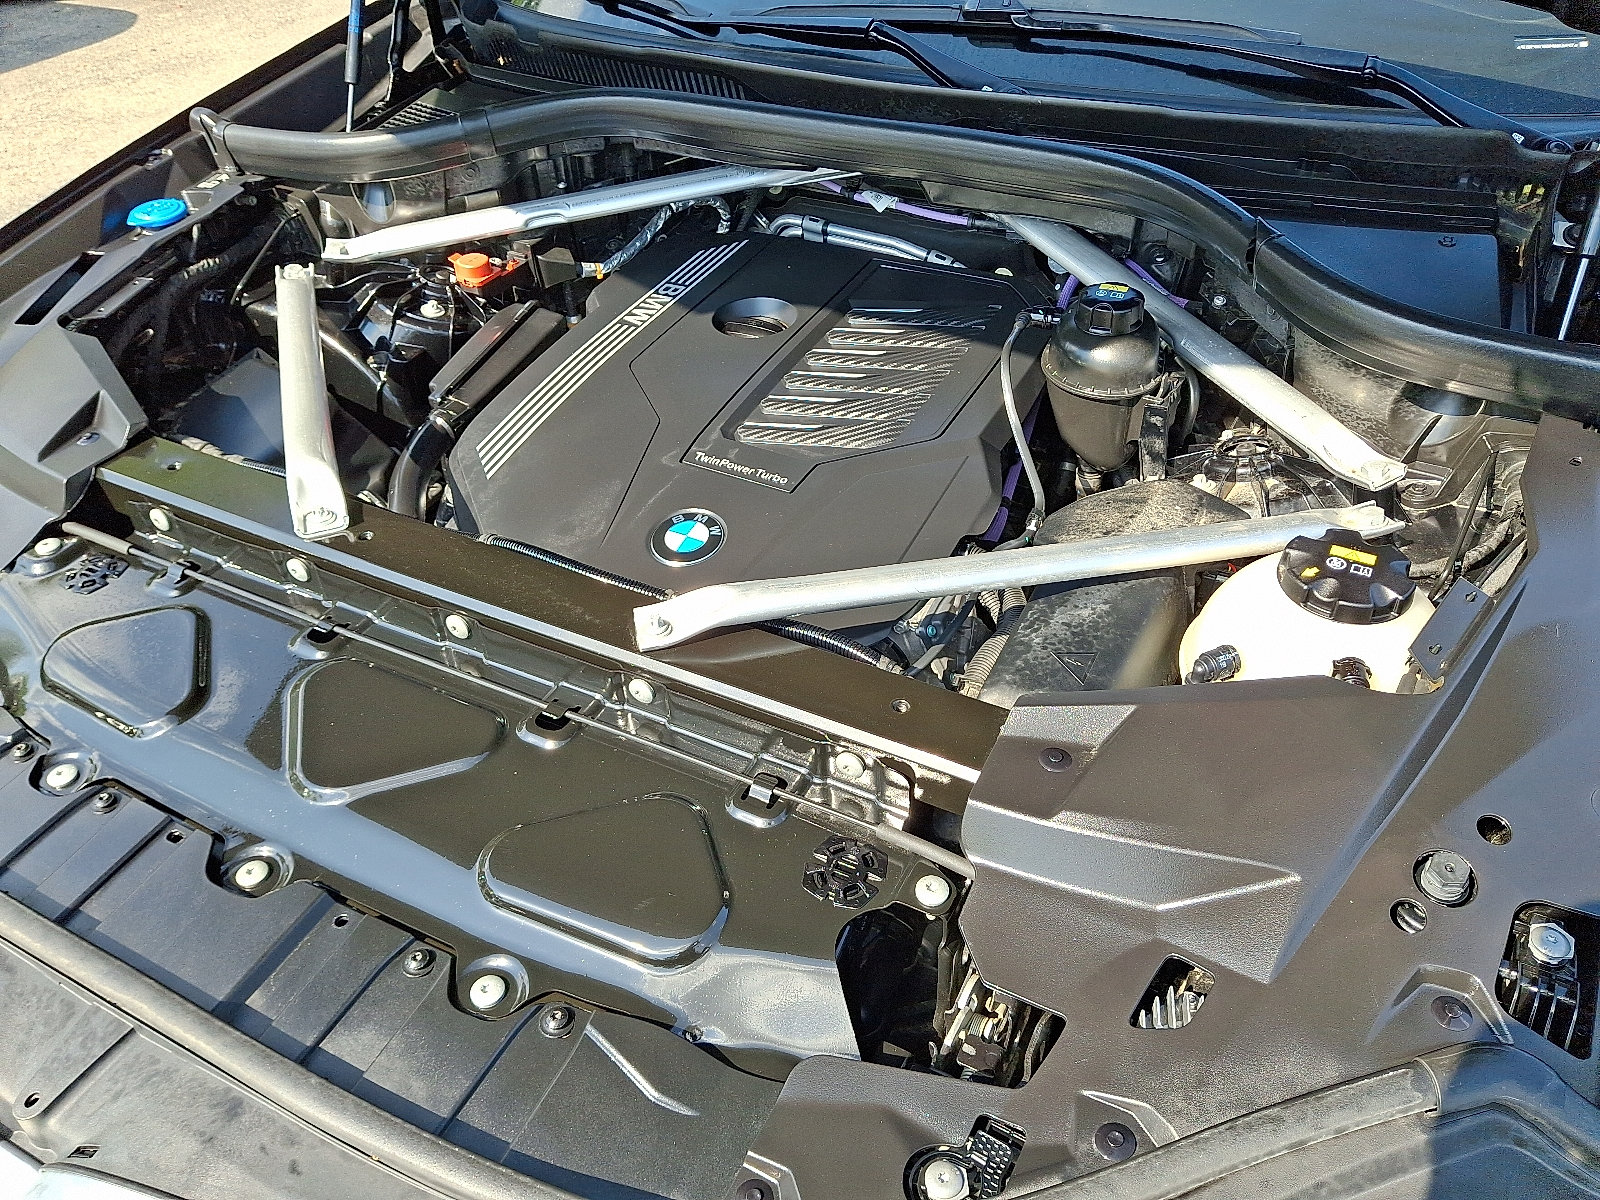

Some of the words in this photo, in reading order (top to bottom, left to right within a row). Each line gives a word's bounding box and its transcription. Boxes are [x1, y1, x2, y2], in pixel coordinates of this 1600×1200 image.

[622, 283, 687, 327] BMW
[694, 452, 755, 475] TwinPower
[756, 468, 788, 485] Turbo
[671, 513, 722, 536] BMW
